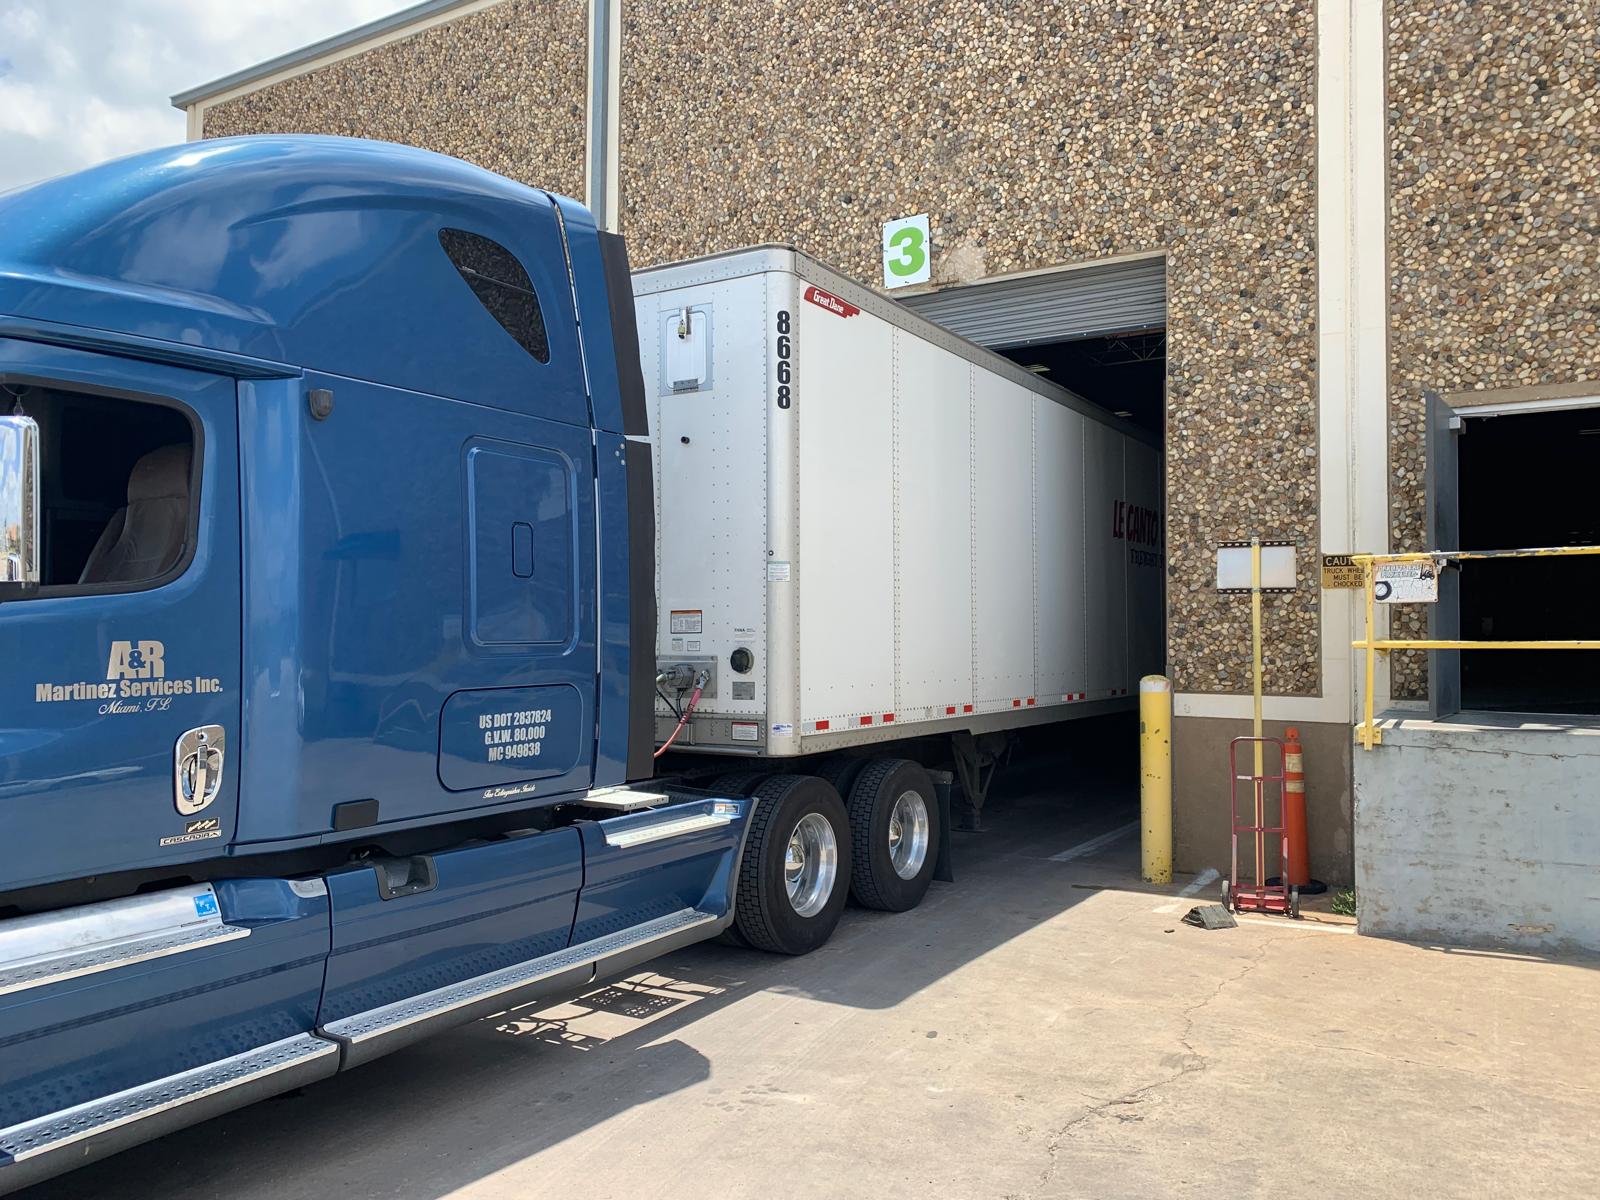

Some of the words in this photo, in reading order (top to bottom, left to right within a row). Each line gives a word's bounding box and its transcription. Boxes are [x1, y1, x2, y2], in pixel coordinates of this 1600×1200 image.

[888, 226, 925, 276] 3
[813, 290, 830, 307] Great
[830, 297, 844, 313] Dane
[777, 310, 791, 410] 8668
[1112, 500, 1125, 539] LE
[1325, 557, 1353, 566] CAUT
[106, 640, 164, 680] A&R
[35, 682, 117, 702] Martinez
[120, 679, 193, 697] Services
[195, 676, 223, 693] Inc.
[144, 697, 173, 712] FL
[479, 715, 492, 729] US
[494, 713, 512, 727] DOT
[513, 709, 552, 726] 2837824
[484, 730, 512, 745] G.V.W.
[514, 725, 545, 742] 80,000
[488, 746, 504, 762] MC
[505, 742, 541, 760] 949838
[163, 832, 210, 845] CASCADIA
